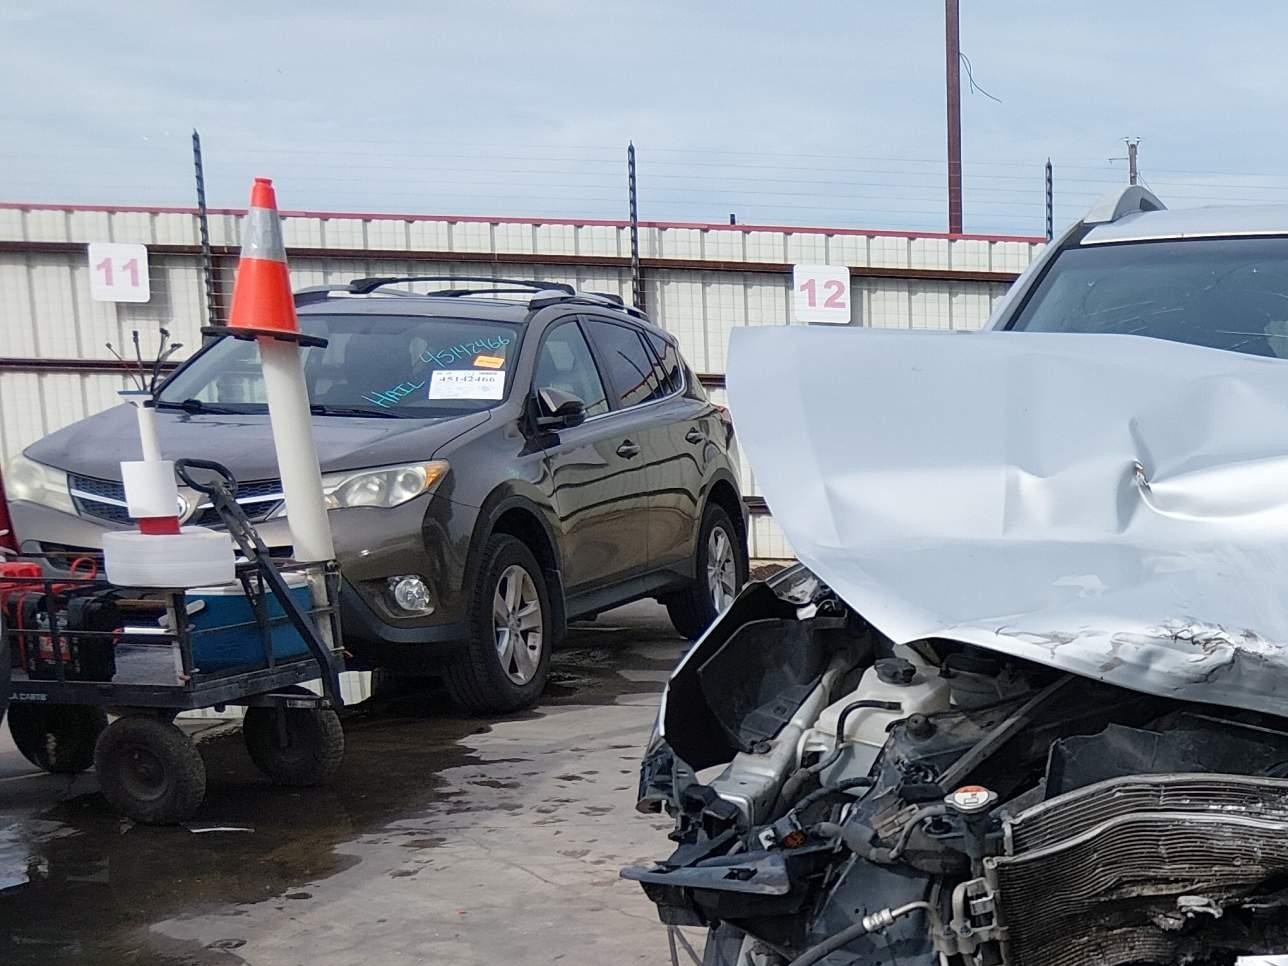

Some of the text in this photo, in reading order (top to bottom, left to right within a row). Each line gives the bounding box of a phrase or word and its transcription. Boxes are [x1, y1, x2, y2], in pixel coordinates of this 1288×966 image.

[95, 257, 140, 288] 11
[799, 278, 847, 309] 12
[419, 335, 511, 368] 45142466
[360, 380, 426, 409] HAIL
